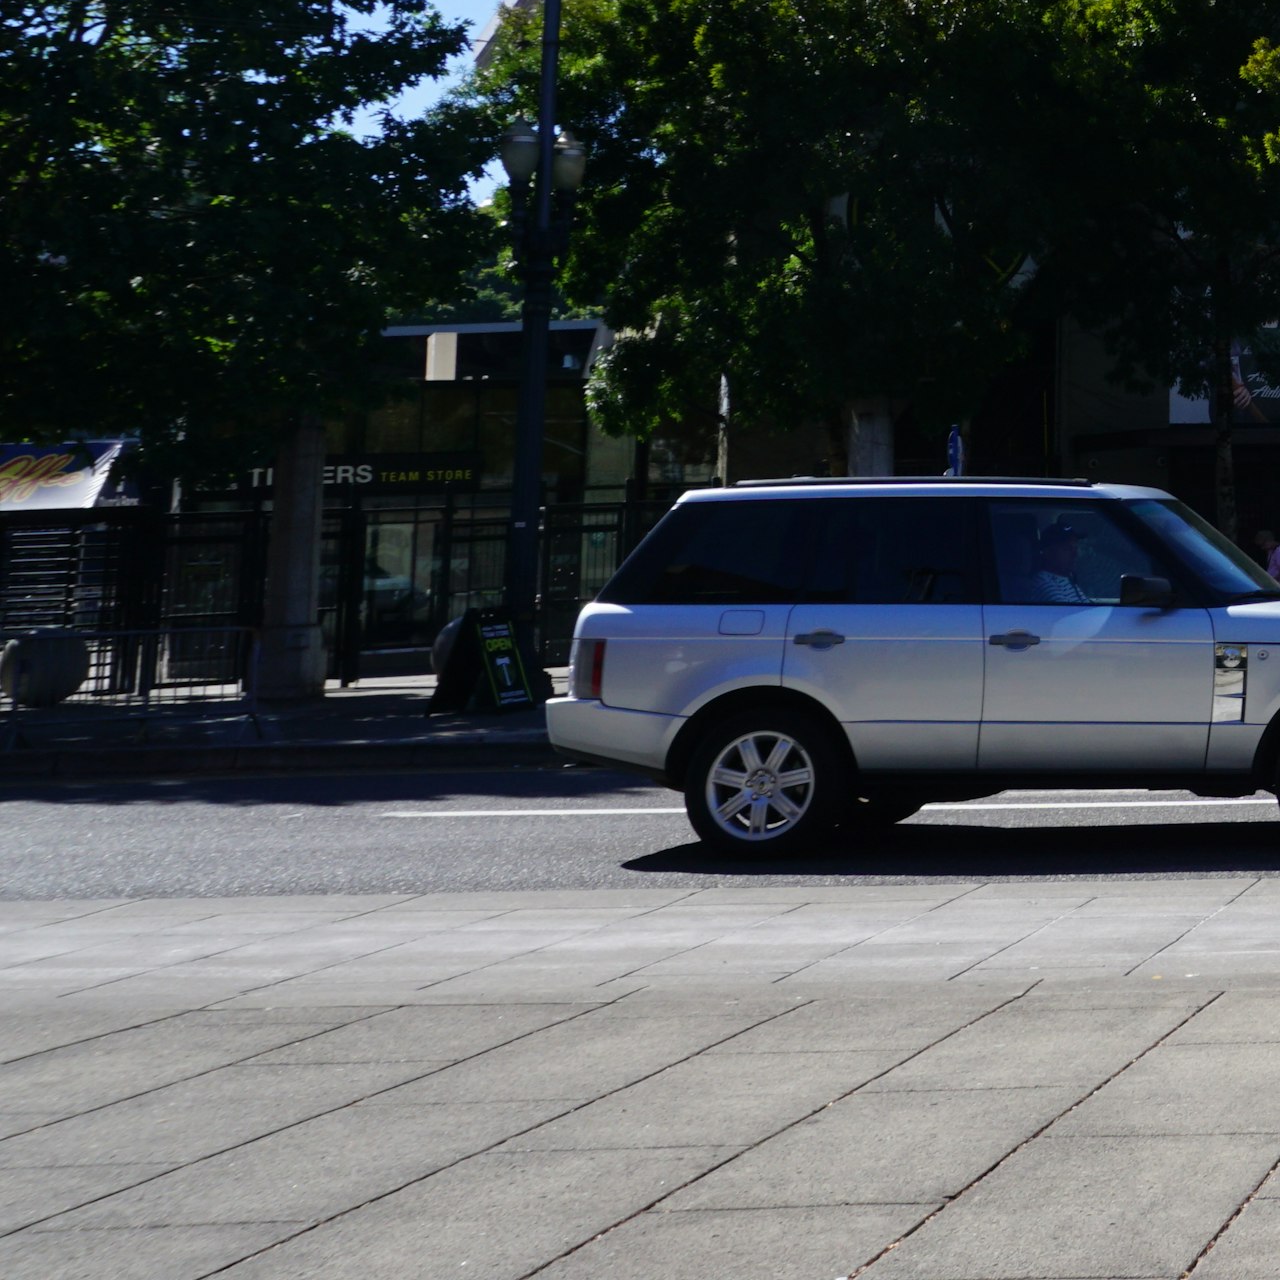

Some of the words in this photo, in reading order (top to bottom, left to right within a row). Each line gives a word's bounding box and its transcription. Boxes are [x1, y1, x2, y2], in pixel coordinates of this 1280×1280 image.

[249, 465, 374, 488] TIERS
[379, 471, 420, 483] TEAM
[426, 469, 472, 482] STORE
[485, 637, 513, 653] OPEN
